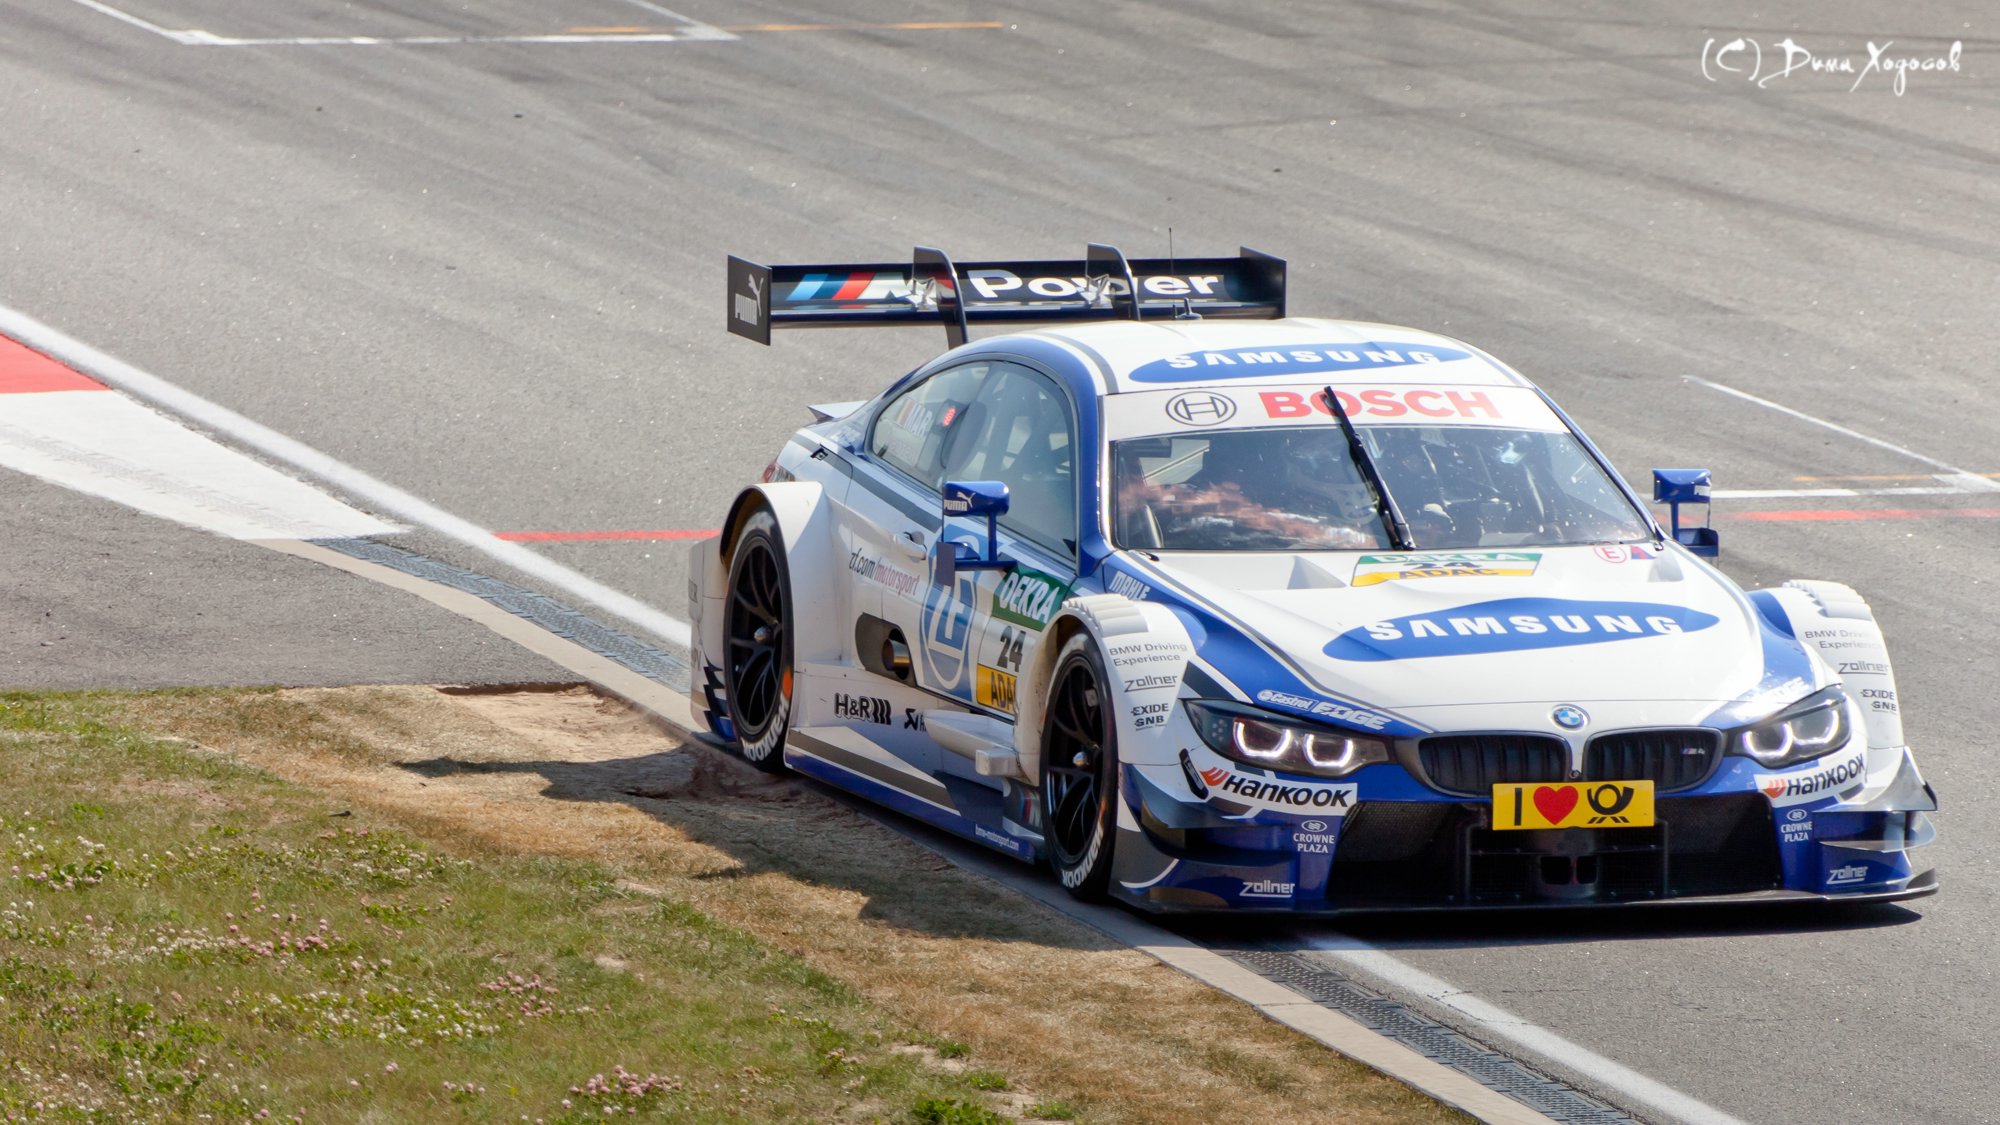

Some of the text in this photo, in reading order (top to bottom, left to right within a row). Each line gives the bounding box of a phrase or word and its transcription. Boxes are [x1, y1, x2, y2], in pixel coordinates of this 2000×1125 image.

[1168, 350, 1441, 369] SAMSUNG
[1258, 389, 1502, 420] BOSCH
[1399, 568, 1499, 579] ADAC
[1108, 570, 1151, 600] MAHLE
[999, 571, 1060, 624] DEKRA
[1370, 614, 1683, 641] SAMSUNG
[1805, 629, 1836, 639] BMW
[997, 625, 1027, 672] 24
[1109, 643, 1188, 656] BMW Driving
[1113, 654, 1181, 667] Experience
[1861, 689, 1895, 700] EXIDE
[1130, 703, 1169, 716] EXIDE
[1270, 693, 1392, 730] Castrol EDGE
[1780, 821, 1813, 832] CROWNE
[1293, 833, 1335, 844] CROWNE
[1784, 833, 1809, 842] PLAZA
[1297, 843, 1329, 854] PLAZA
